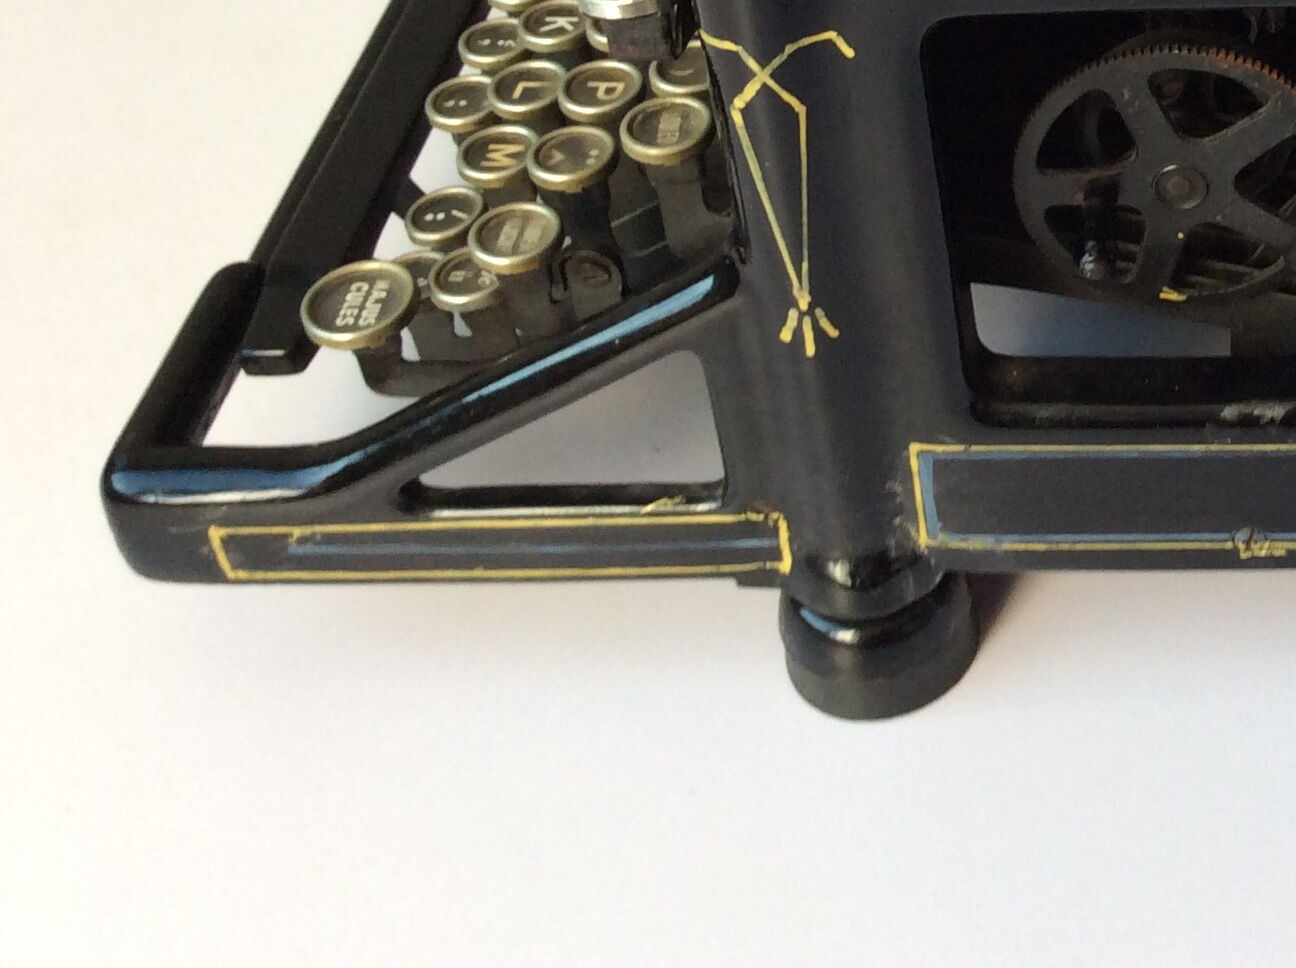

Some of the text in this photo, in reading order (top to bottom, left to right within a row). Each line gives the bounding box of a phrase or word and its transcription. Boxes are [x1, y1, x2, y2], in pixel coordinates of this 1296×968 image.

[540, 15, 580, 33] K
[511, 79, 550, 100] L
[586, 80, 626, 101] P
[480, 143, 525, 167] M
[334, 279, 370, 328] CULES
